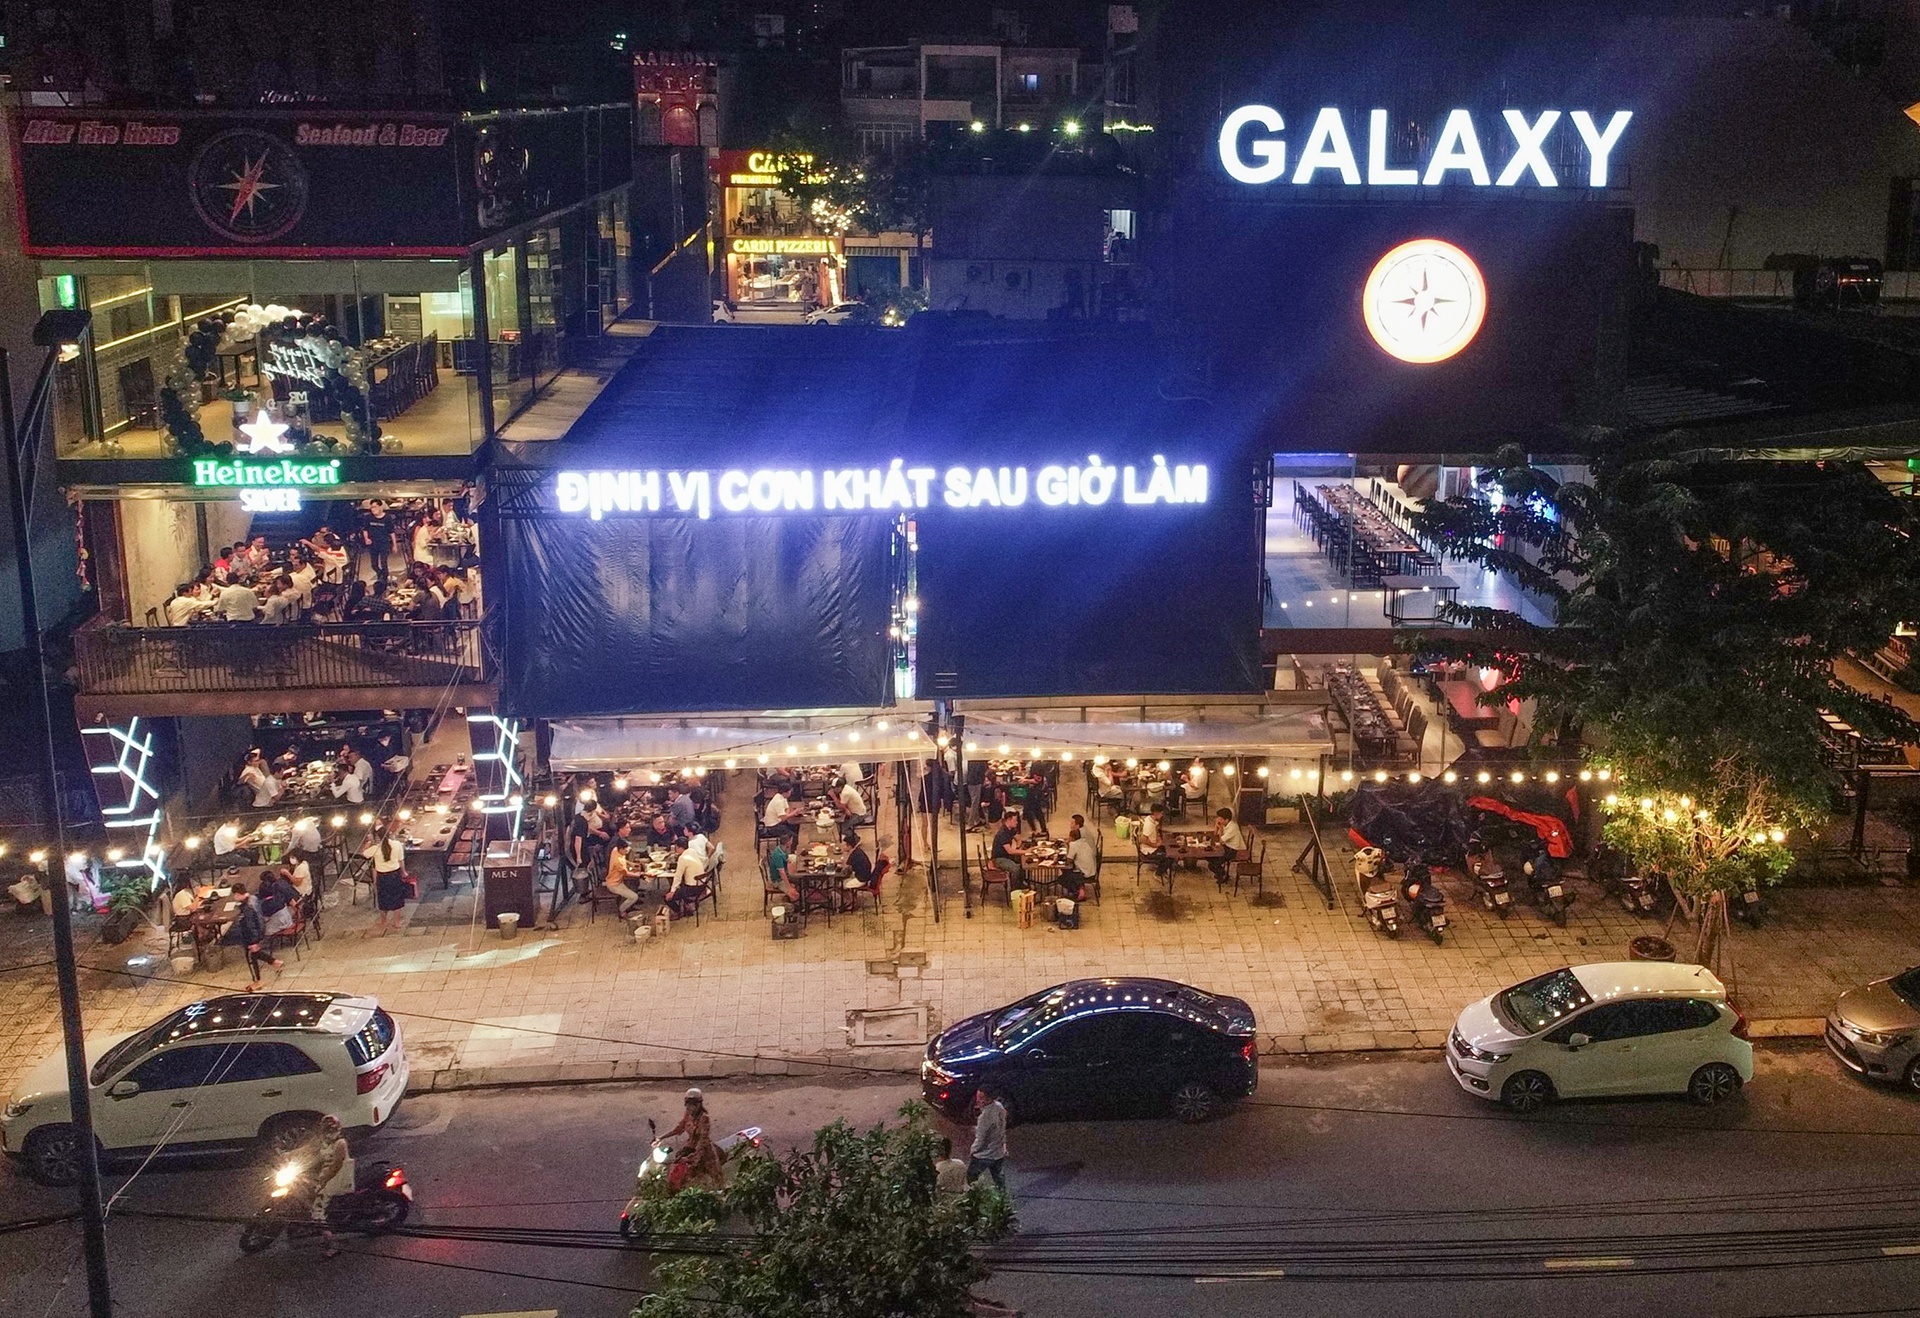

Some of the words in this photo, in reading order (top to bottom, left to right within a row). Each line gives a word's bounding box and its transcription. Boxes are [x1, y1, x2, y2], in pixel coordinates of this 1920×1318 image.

[296, 123, 379, 146] Seafood
[379, 123, 396, 146] &
[400, 124, 449, 147] Beer
[1218, 104, 1634, 188] GALAXY
[733, 239, 774, 253] CARDI
[775, 239, 837, 253] PIZZERIA
[193, 459, 340, 486] Heineken
[556, 471, 661, 521] ĐỊNH
[668, 471, 711, 520] VỊ
[718, 469, 814, 512] CƠN
[823, 458, 937, 510] KHÁT
[943, 466, 1028, 507] SAU
[1035, 454, 1118, 506] GIỜ
[1123, 454, 1208, 505] LÀM
